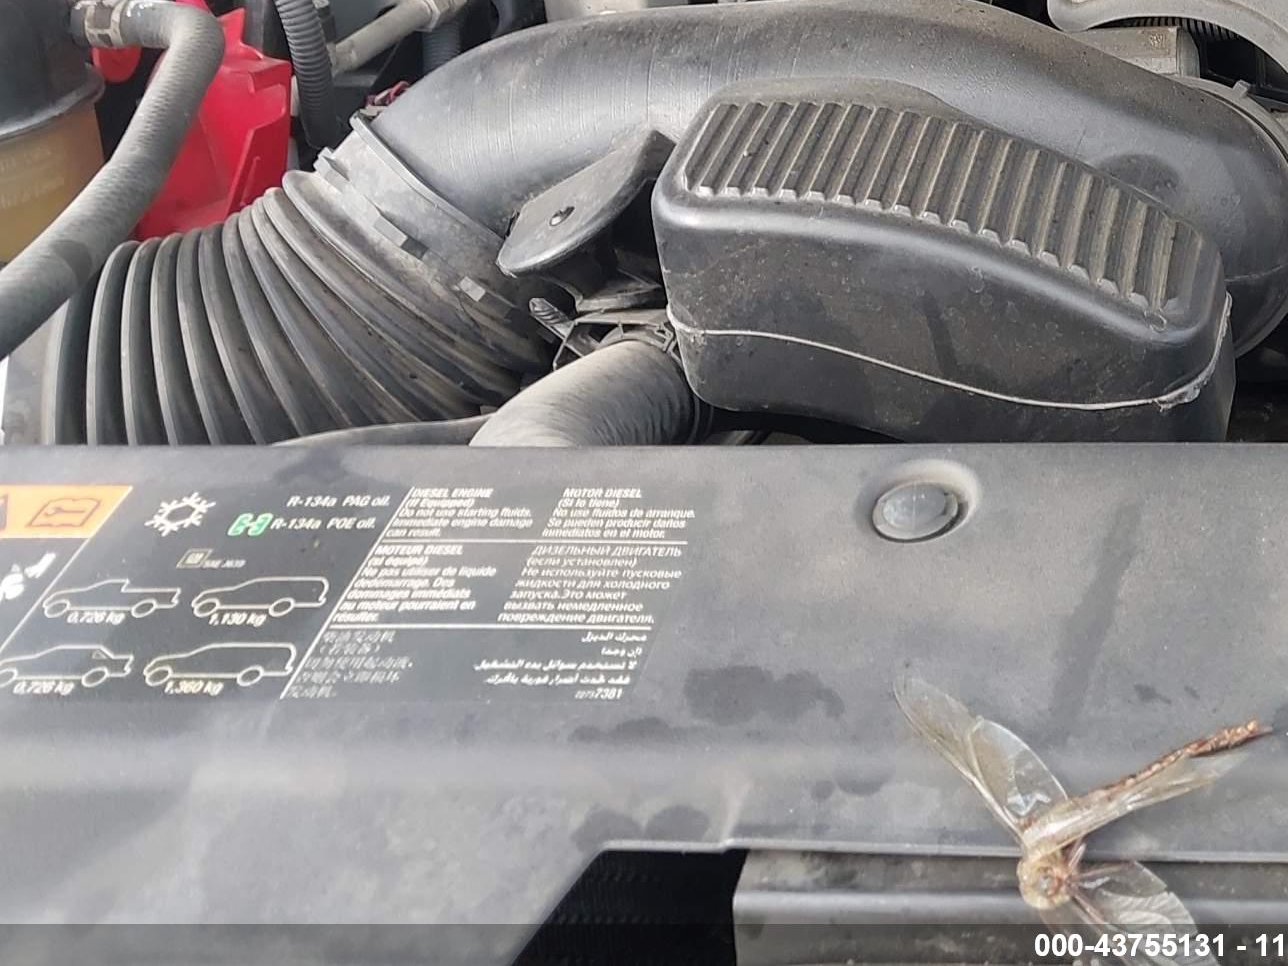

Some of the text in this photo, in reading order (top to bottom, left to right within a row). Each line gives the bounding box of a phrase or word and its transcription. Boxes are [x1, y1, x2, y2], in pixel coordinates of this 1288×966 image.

[411, 488, 493, 498] DIESEL ENGINE
[563, 488, 642, 498] MOTOR DIESEL
[286, 495, 337, 507] R-134a
[342, 495, 371, 507] PAG
[553, 508, 567, 518] No
[570, 508, 589, 518] use
[629, 508, 644, 518] de
[270, 518, 321, 529] R-134a
[326, 518, 357, 529] POE
[605, 518, 651, 528] producir
[375, 545, 463, 555] MOTEUR DIESEL
[611, 545, 682, 556] ДВИГАТЕЛЬ
